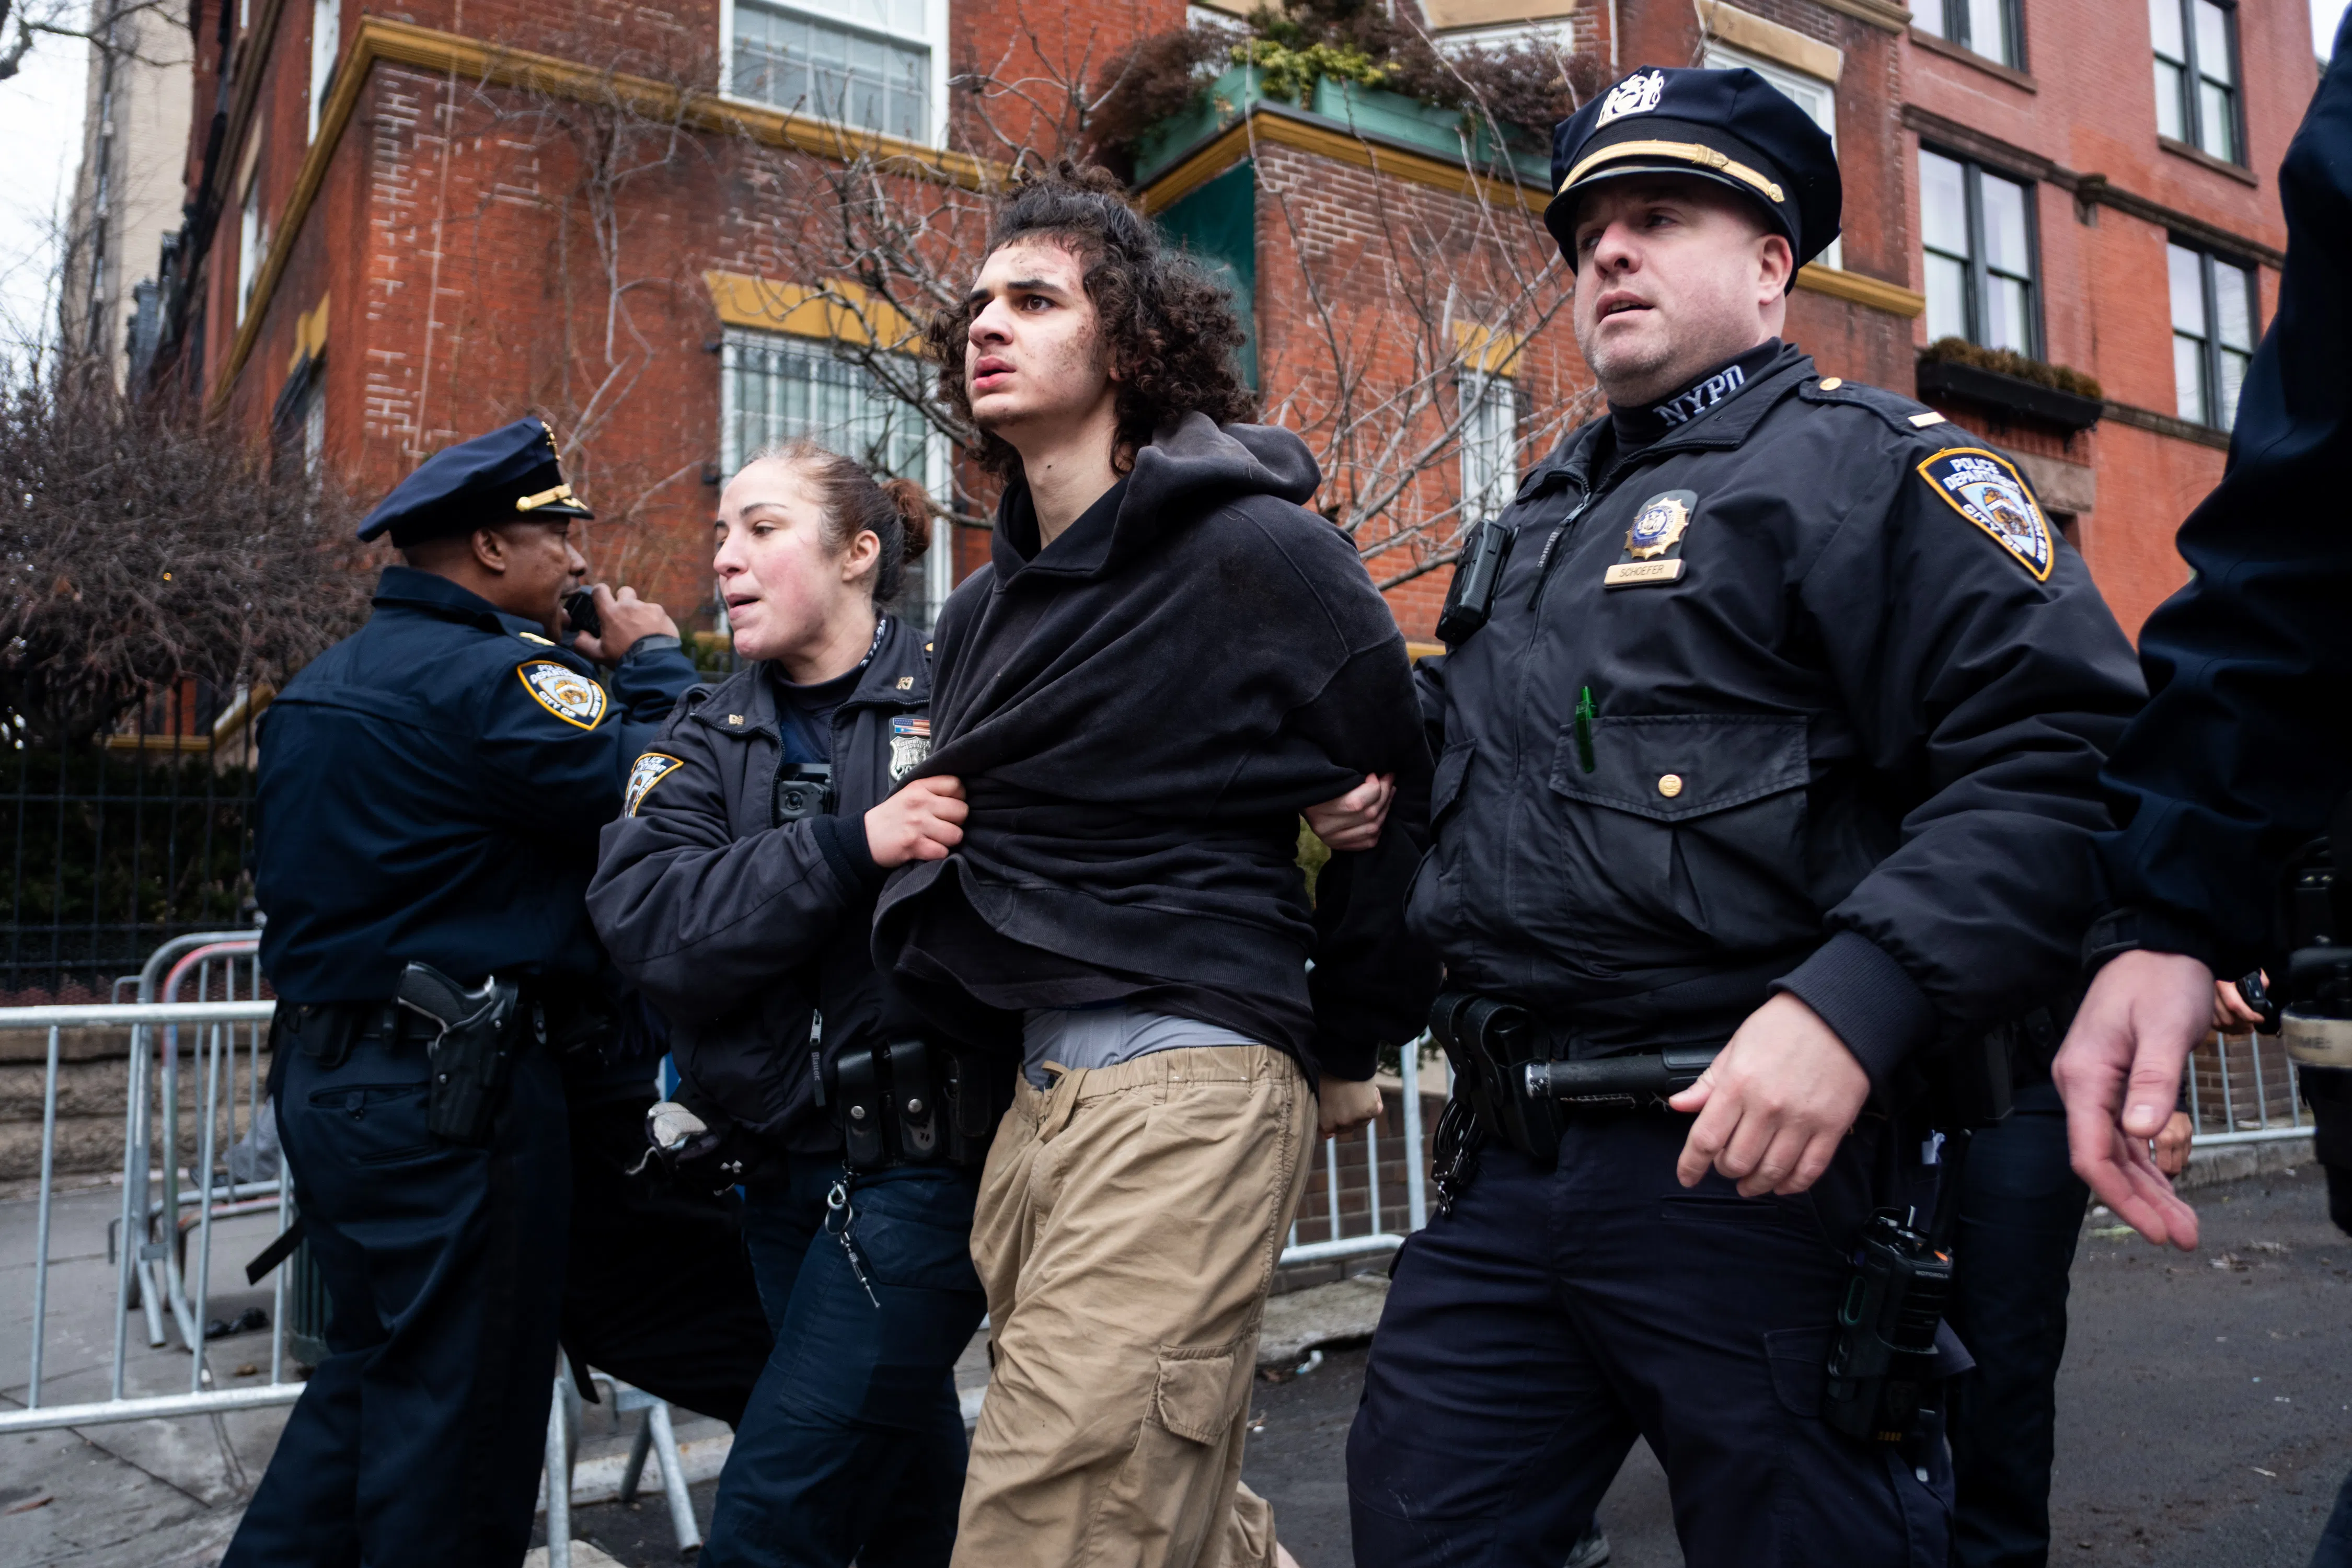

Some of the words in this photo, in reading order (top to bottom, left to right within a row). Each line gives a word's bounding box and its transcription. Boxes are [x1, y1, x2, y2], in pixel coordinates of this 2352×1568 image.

[1653, 365, 1745, 426] NYPD
[1950, 457, 2000, 474] POLICE
[1963, 504, 2001, 531] CITY
[1619, 564, 1665, 577] SCHOEFER
